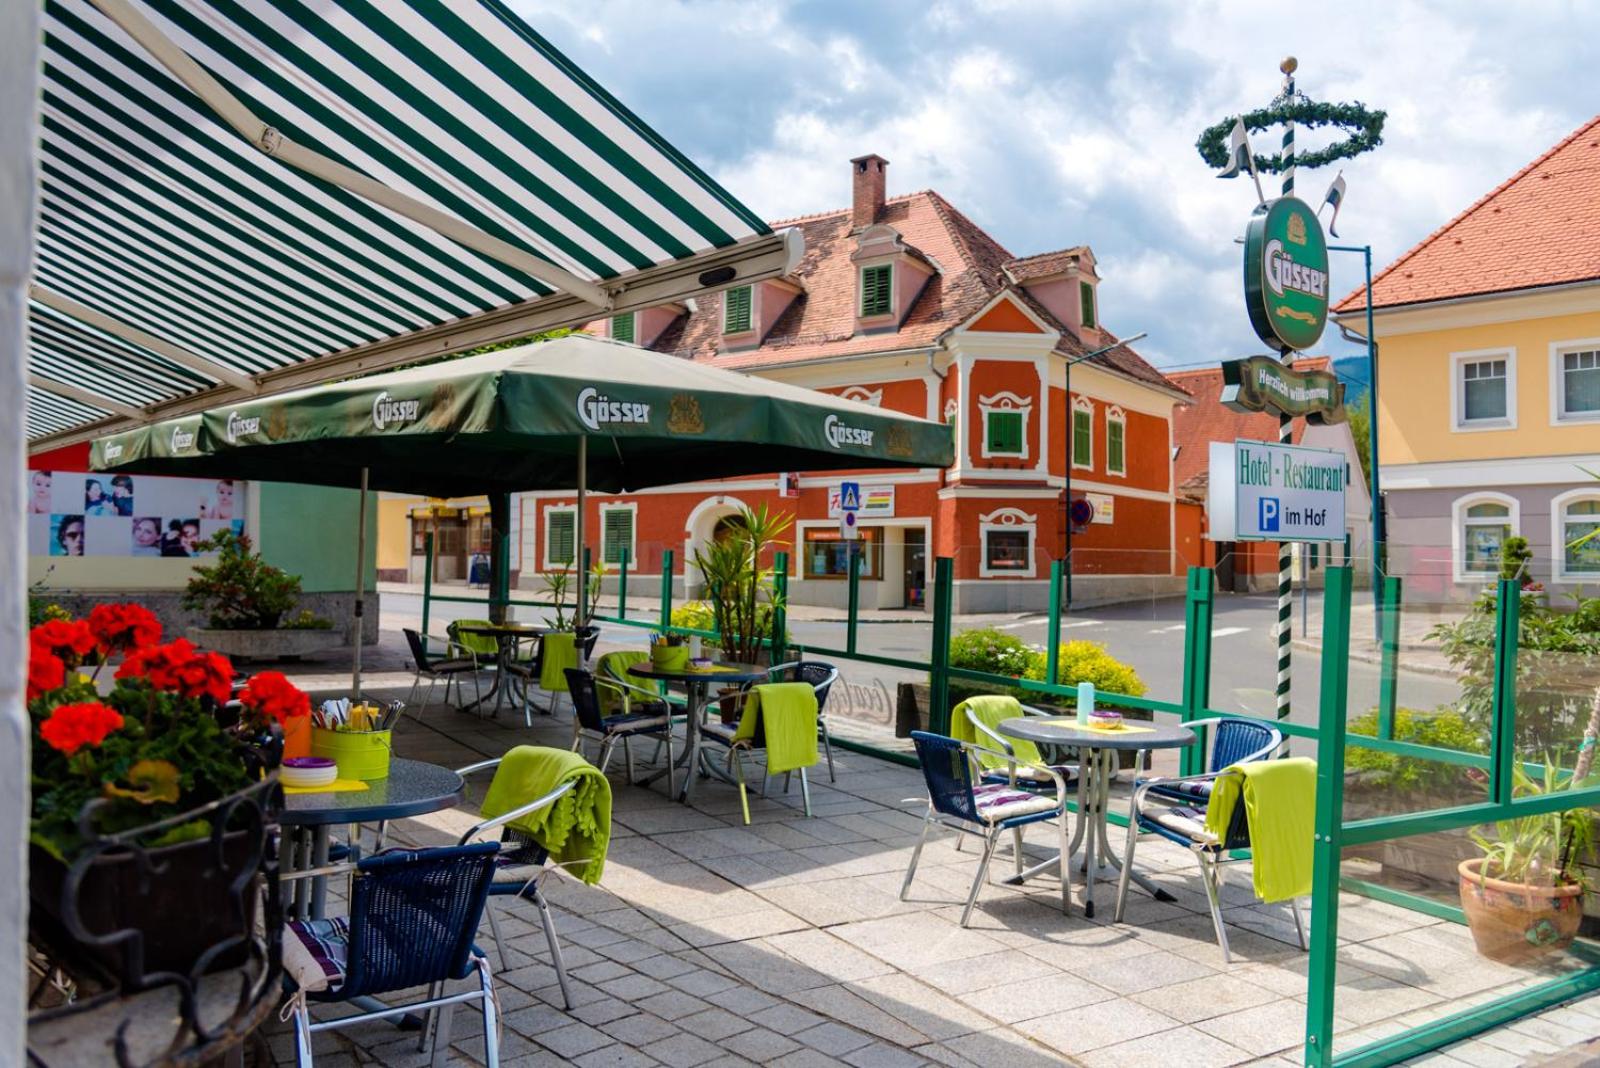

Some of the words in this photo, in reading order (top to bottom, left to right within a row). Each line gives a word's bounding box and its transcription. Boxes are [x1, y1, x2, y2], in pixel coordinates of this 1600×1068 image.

[1264, 239, 1327, 298] Gösser
[1259, 369, 1289, 398] Herzlich
[373, 391, 419, 430] Gösser
[577, 387, 650, 430] Gösser
[227, 411, 260, 443] Gösser
[824, 414, 873, 448] Gösser
[1240, 449, 1272, 486] Hotel
[1283, 453, 1343, 492] Restaurant
[1285, 506, 1301, 525] im
[1304, 508, 1327, 527] Hof
